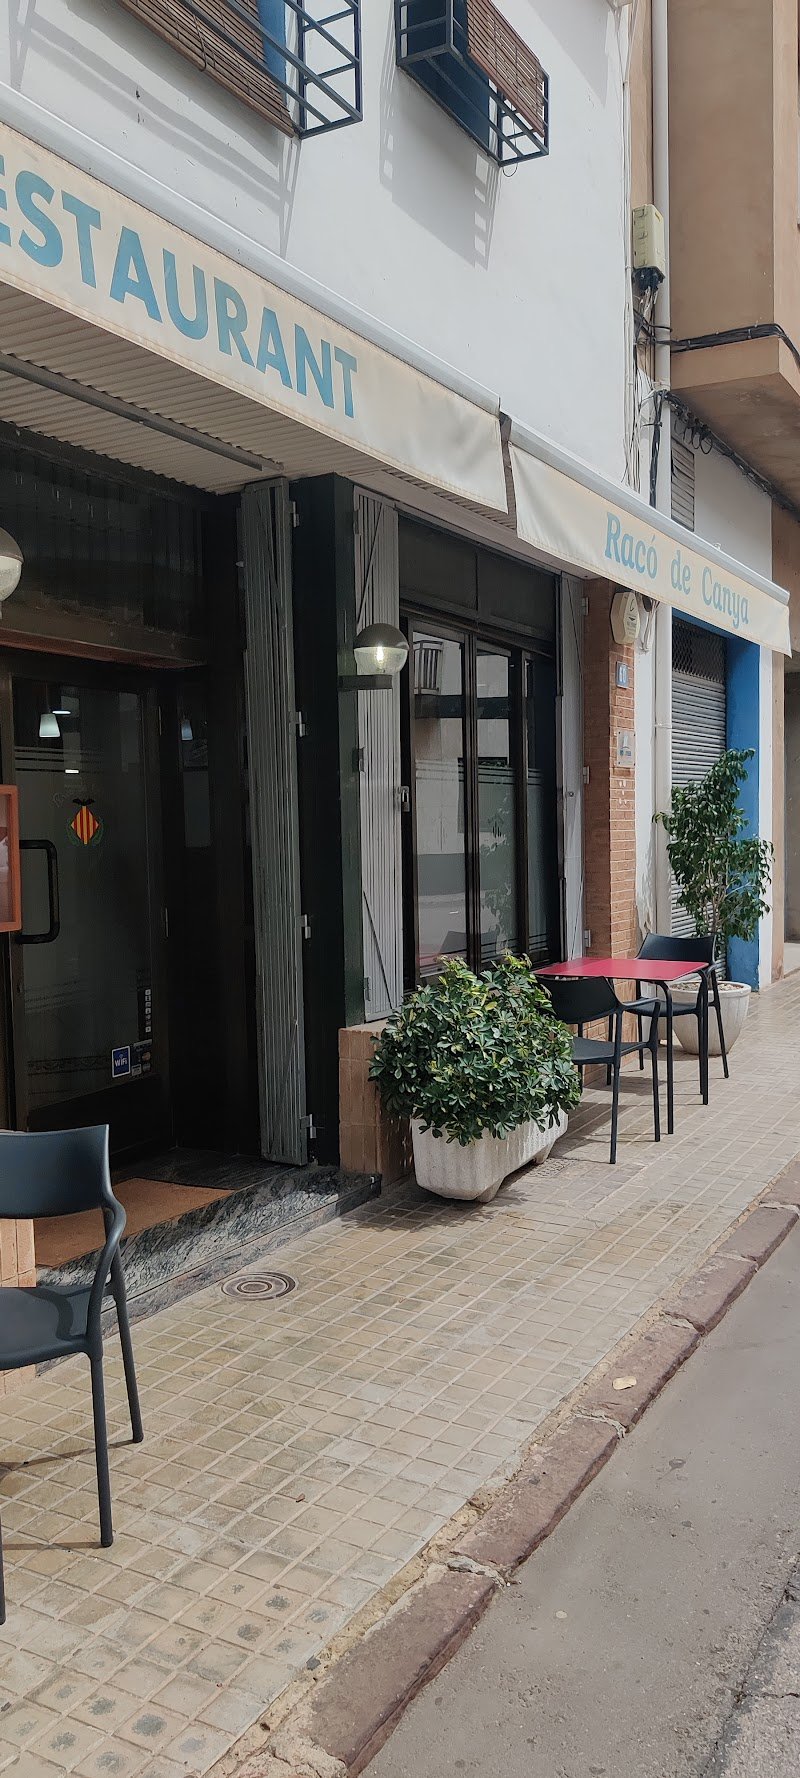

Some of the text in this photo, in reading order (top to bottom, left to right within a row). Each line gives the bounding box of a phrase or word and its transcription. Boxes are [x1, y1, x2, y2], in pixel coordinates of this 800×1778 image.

[604, 511, 749, 629] Racó de Canya
